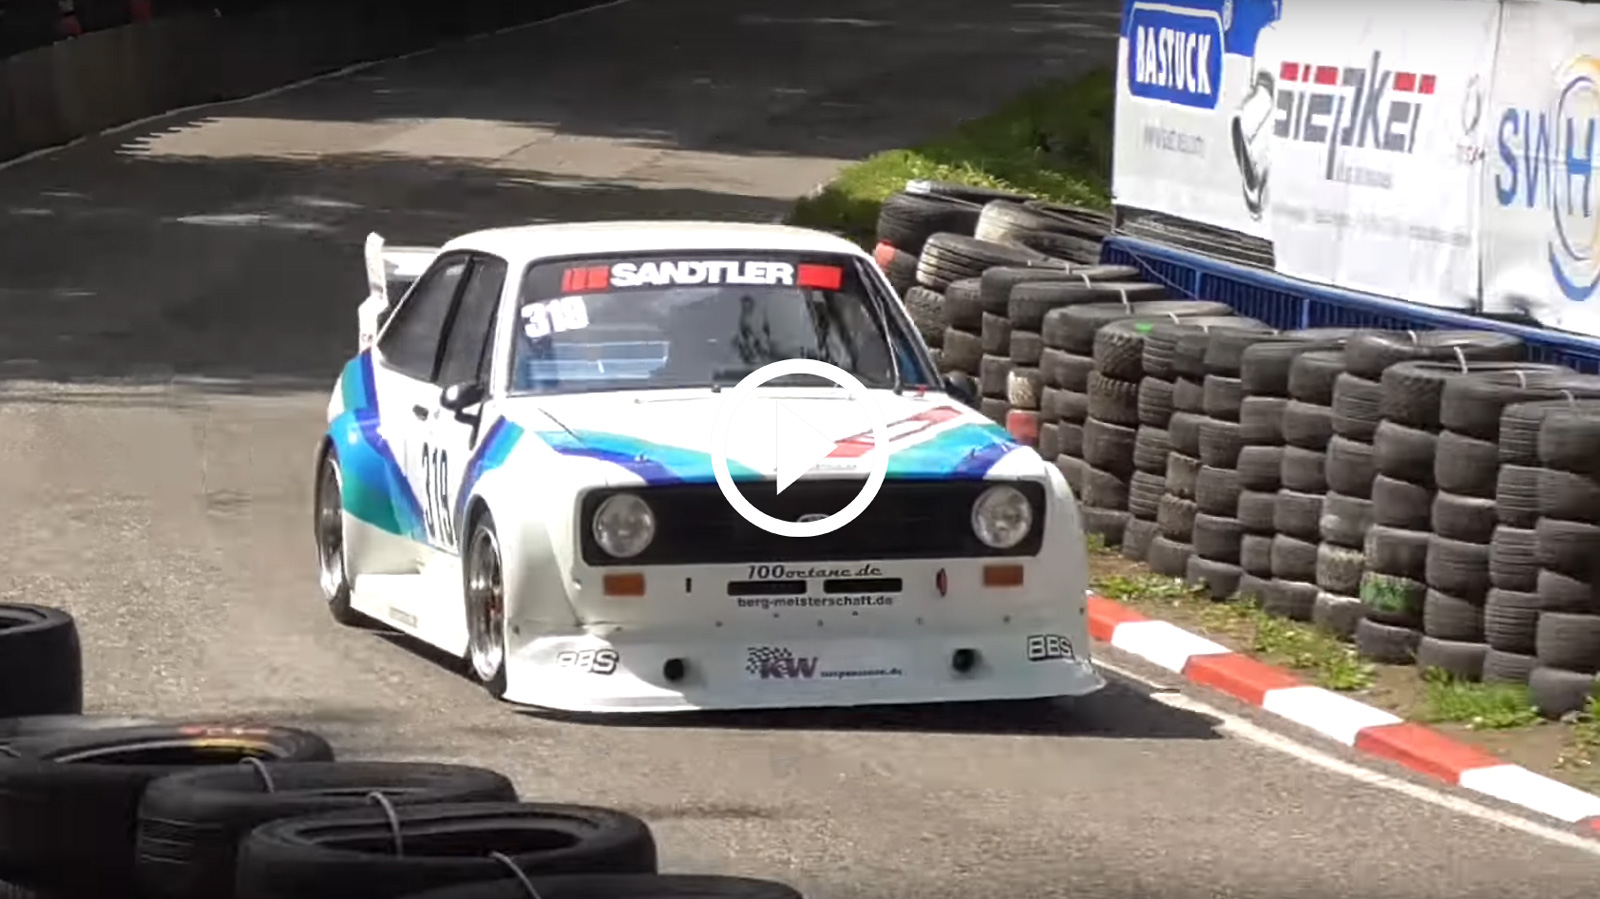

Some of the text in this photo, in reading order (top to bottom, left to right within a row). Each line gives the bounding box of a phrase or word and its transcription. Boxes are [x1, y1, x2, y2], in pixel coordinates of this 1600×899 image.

[1136, 24, 1212, 96] BASTUCK
[609, 261, 795, 287] SANDTLER
[422, 441, 454, 547] 319
[737, 595, 894, 609] berg-meisterschaft.de
[556, 648, 620, 676] BBS
[1027, 634, 1076, 662] BBS
[758, 656, 819, 680] KW
